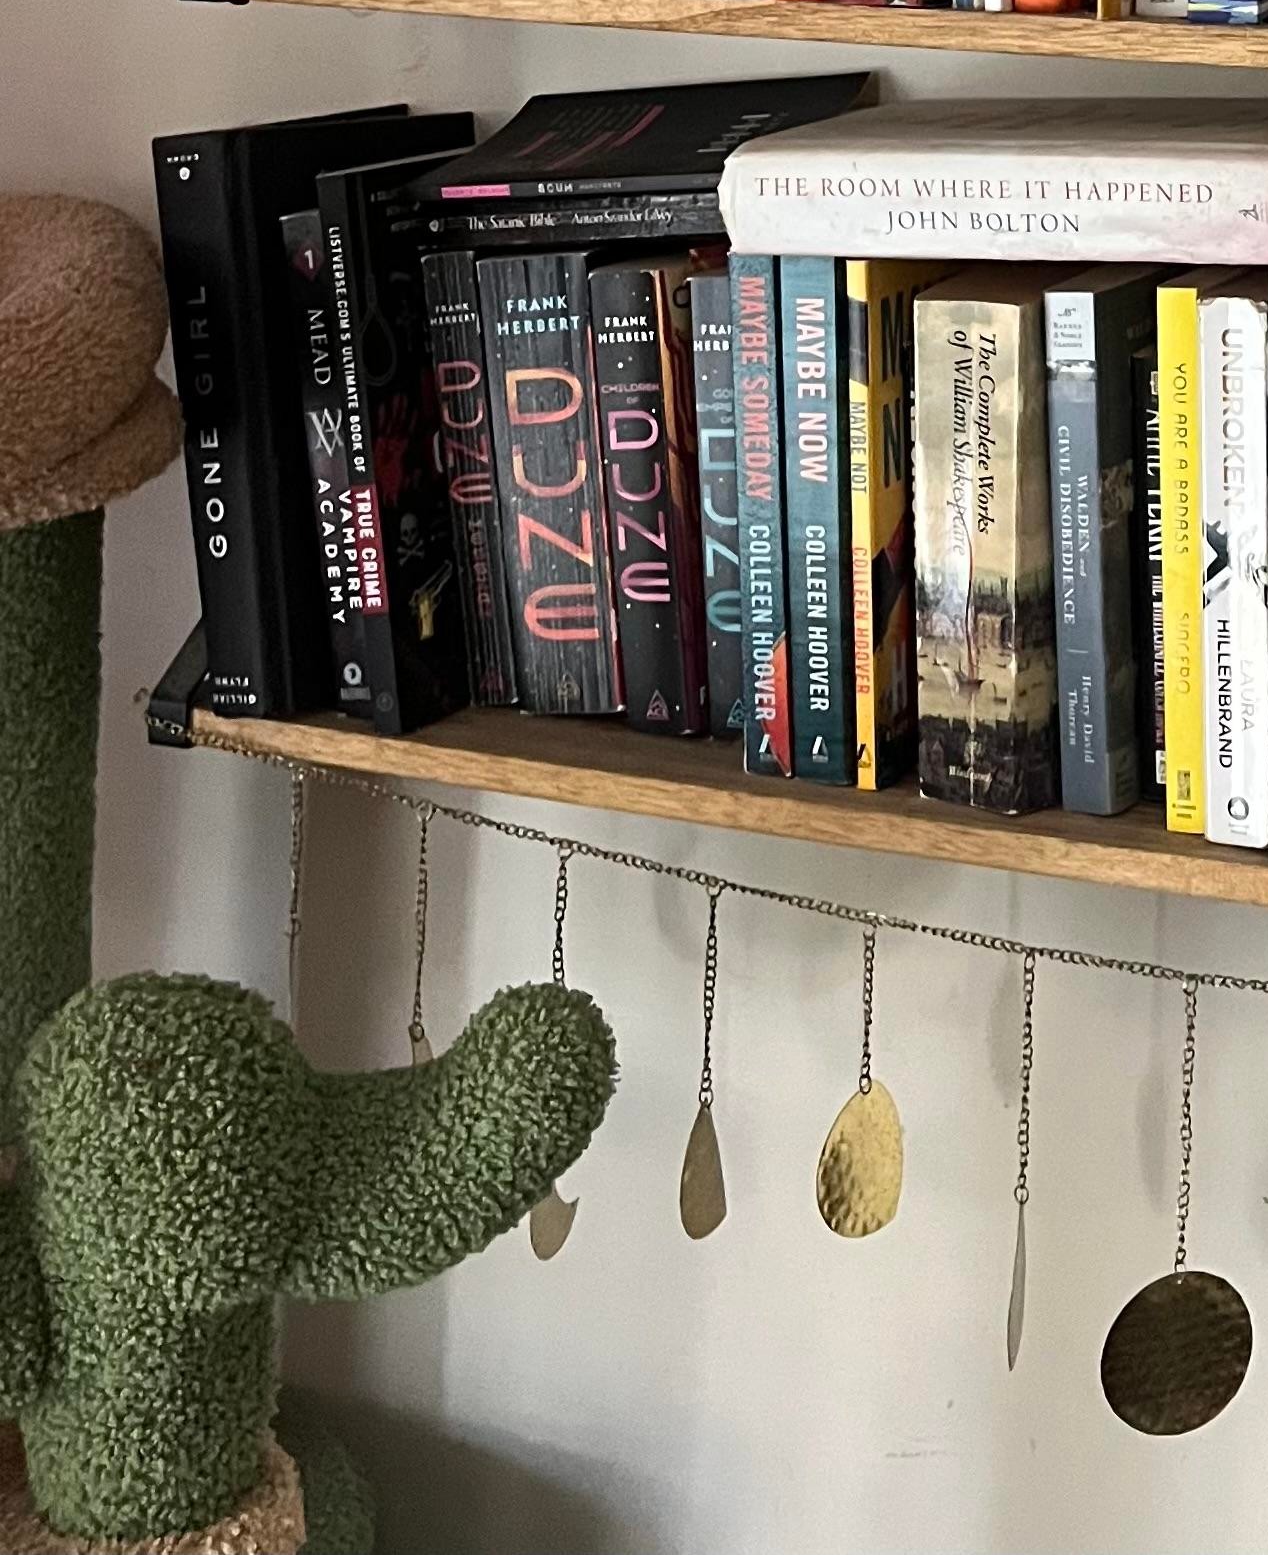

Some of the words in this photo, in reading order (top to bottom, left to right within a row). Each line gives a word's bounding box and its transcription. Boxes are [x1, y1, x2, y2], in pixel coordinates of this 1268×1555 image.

[886, 210, 960, 233] JOHN
[970, 212, 1080, 233] BOLTON
[506, 294, 568, 314] FRANK
[604, 316, 649, 328] FRANK
[741, 278, 767, 364] MAYBE
[601, 382, 659, 394] CHILDREN
[796, 298, 826, 399] MAYBE
[743, 374, 771, 501] SOMEDAY
[798, 412, 827, 482] NOW
[338, 490, 361, 609] VAMPIRE
[356, 490, 374, 538] TRUE
[361, 547, 381, 608] CRIME
[749, 525, 773, 623] COLLEEN
[805, 525, 826, 617] COLLEEN
[753, 632, 776, 720] HOOVER
[808, 626, 829, 711] HOOVER
